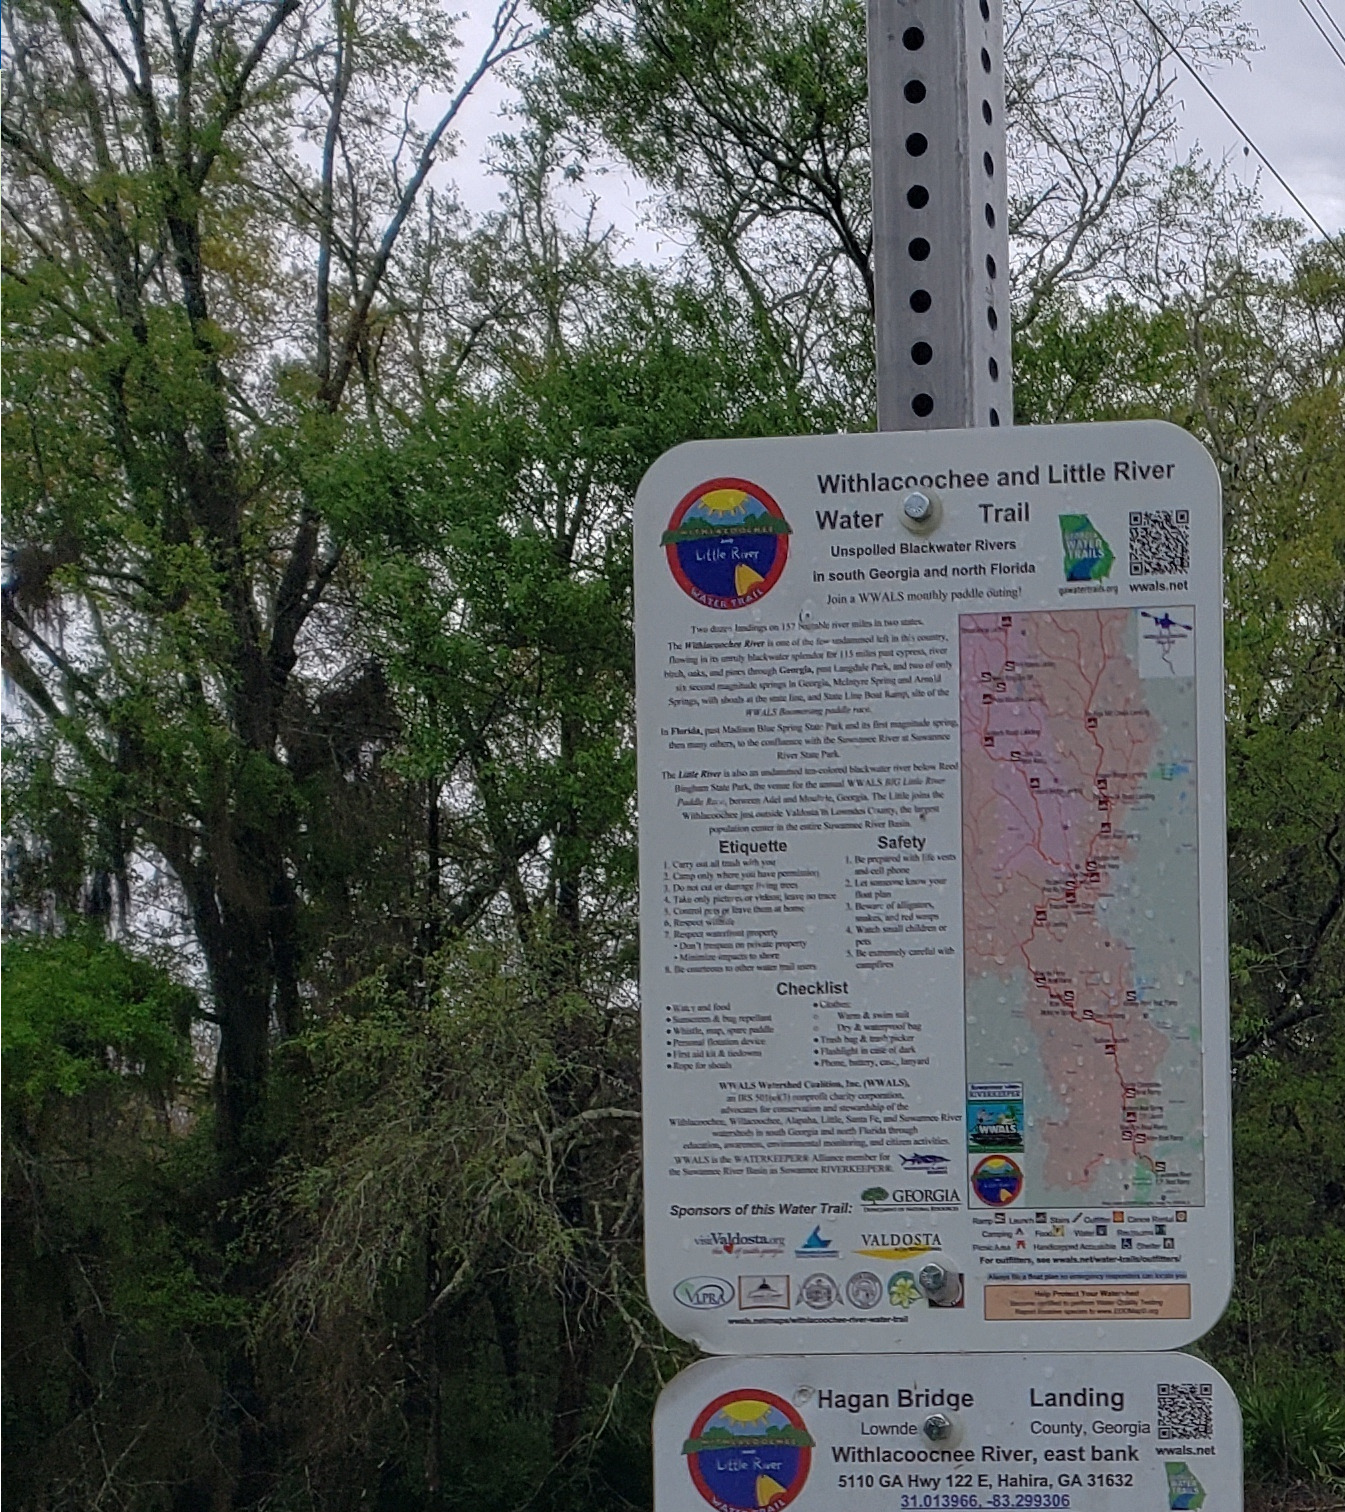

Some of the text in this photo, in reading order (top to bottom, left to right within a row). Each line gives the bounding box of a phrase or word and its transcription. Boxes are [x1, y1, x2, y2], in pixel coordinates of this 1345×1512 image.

[997, 466, 1039, 485] and
[1048, 464, 1105, 483] Little
[1114, 461, 1175, 480] River
[978, 502, 1029, 522] Trail
[815, 510, 883, 529] Water
[899, 541, 971, 553] Blackwater
[975, 539, 1016, 550] Rivers
[696, 547, 759, 561] Little River
[812, 562, 1035, 581] in south Georgia and north Florida
[1129, 580, 1188, 591] wwals.net
[690, 587, 763, 608] WATER TRAIL
[826, 594, 847, 604] Join
[858, 591, 904, 602] WWALS
[907, 589, 948, 601] monthly
[950, 588, 983, 601] paddle
[986, 586, 1021, 598] outing!
[776, 751, 798, 759] River
[718, 840, 787, 854] Etiquette
[877, 835, 926, 850] Safety
[776, 981, 848, 994] Checklist
[718, 1081, 756, 1090] WWALS
[979, 1124, 1017, 1135] WWALS
[719, 1155, 731, 1163] the
[811, 1153, 844, 1161] Alliance
[845, 1153, 877, 1161] member
[878, 1152, 890, 1160] for
[892, 1189, 960, 1202] GEORGIA
[669, 1205, 731, 1217] Sponsors
[734, 1203, 749, 1215] of
[751, 1203, 775, 1214] this
[778, 1203, 817, 1214] Water
[820, 1202, 852, 1213] Trail:
[860, 1233, 941, 1246] VALDOSTA
[979, 1256, 994, 1264] For
[817, 1388, 973, 1412] Hagan Bridge
[1030, 1388, 1124, 1410] Landing
[860, 1422, 921, 1435] Lownde
[1030, 1420, 1150, 1436] County, Georgia
[981, 1445, 1037, 1463] River,
[1043, 1447, 1085, 1461] east
[1091, 1445, 1138, 1461] bank
[1154, 1445, 1215, 1455] wwals.net
[717, 1457, 783, 1472] Little River
[838, 1473, 1132, 1490] 5110 GA Hwy 122 E, Hahira, GA 31632
[900, 1494, 1070, 1507] 31.013966, -83.299306
